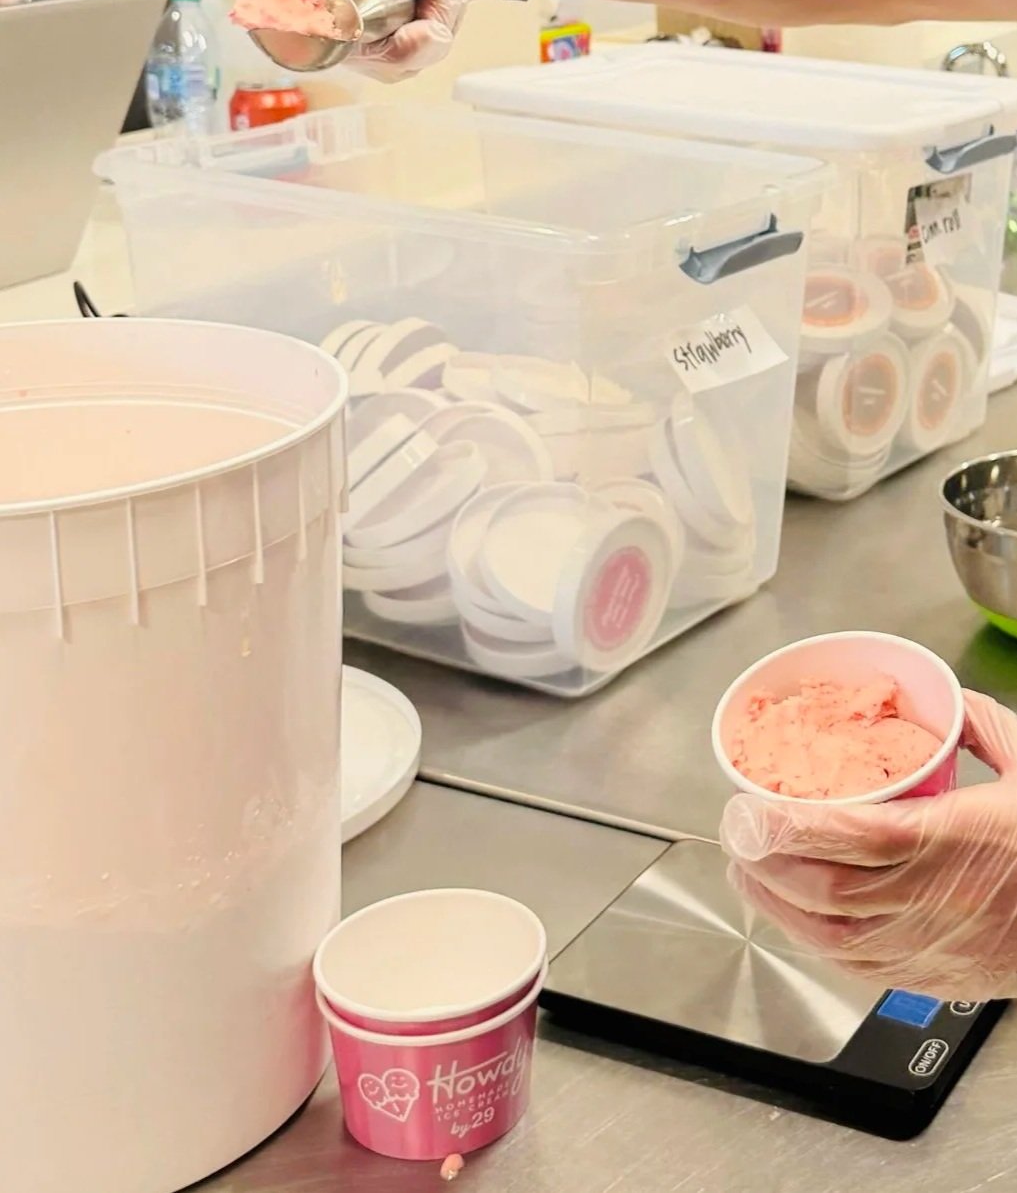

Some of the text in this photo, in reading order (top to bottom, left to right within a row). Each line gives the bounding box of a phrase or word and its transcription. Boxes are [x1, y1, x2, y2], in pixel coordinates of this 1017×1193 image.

[426, 1035, 529, 1105] Howdy
[914, 1041, 942, 1074] ON/OFF
[471, 1106, 495, 1129] 29
